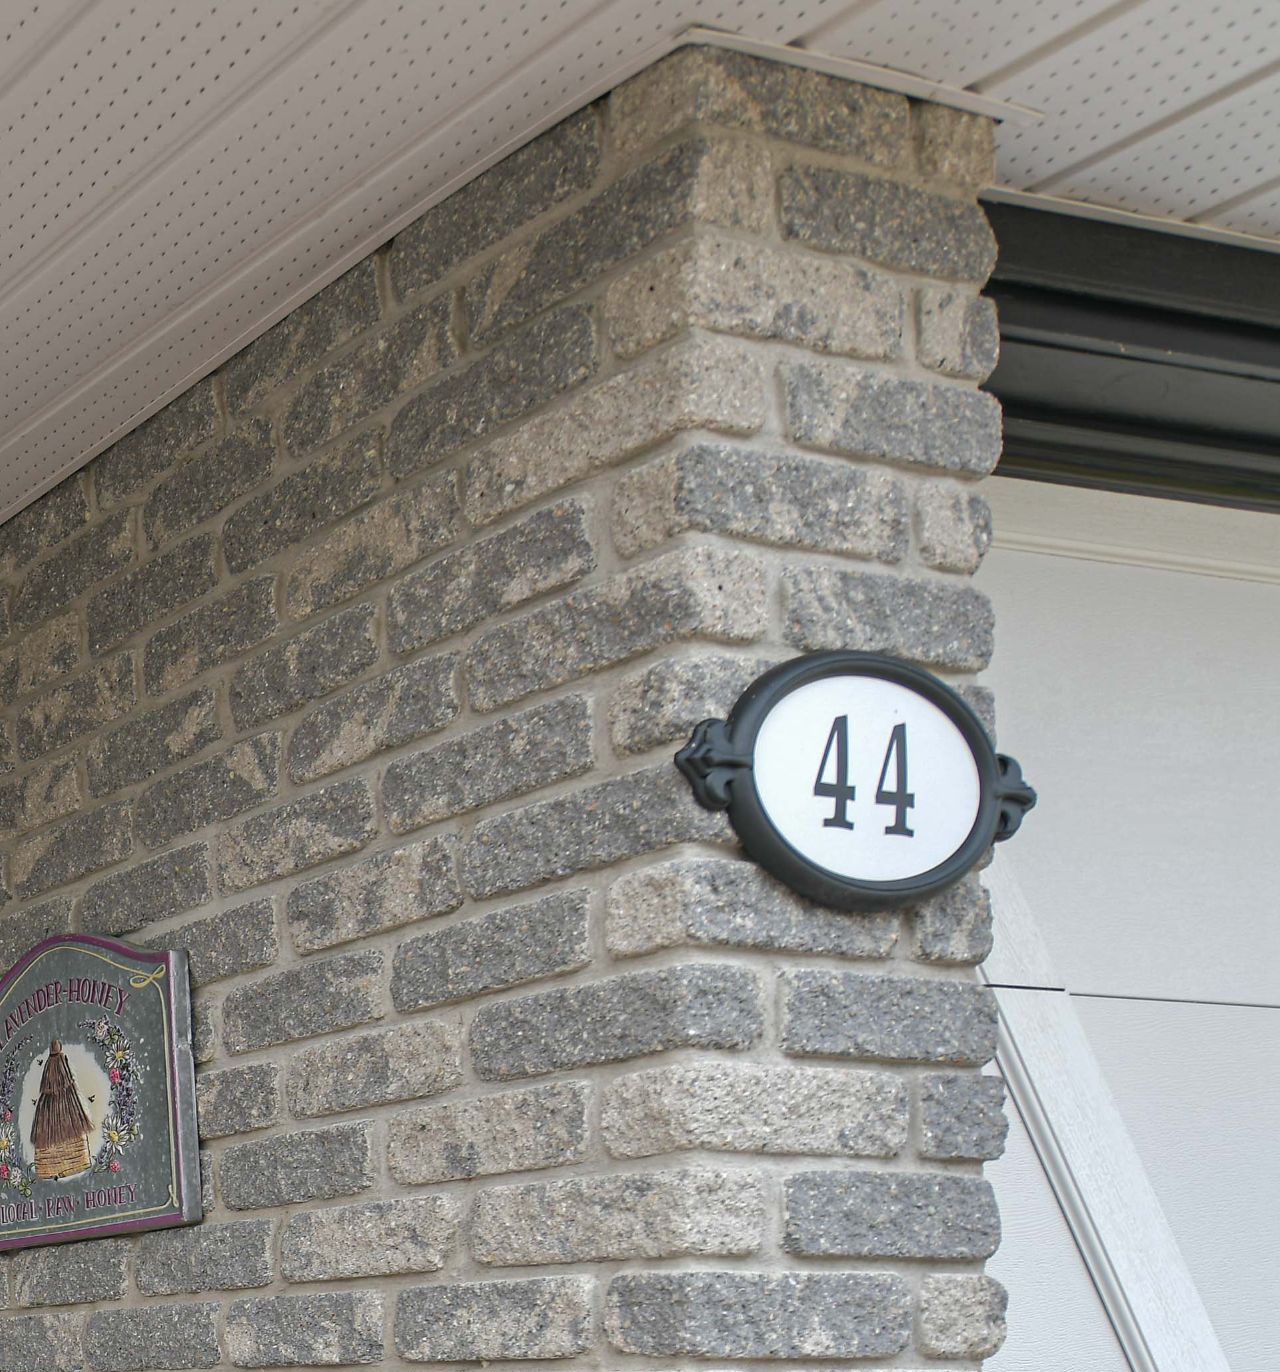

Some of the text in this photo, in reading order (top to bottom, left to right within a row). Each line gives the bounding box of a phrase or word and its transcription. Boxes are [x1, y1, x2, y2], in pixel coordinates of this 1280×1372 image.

[813, 713, 916, 838] 44
[0, 1183, 138, 1225] LOCAL RAW HONEY
